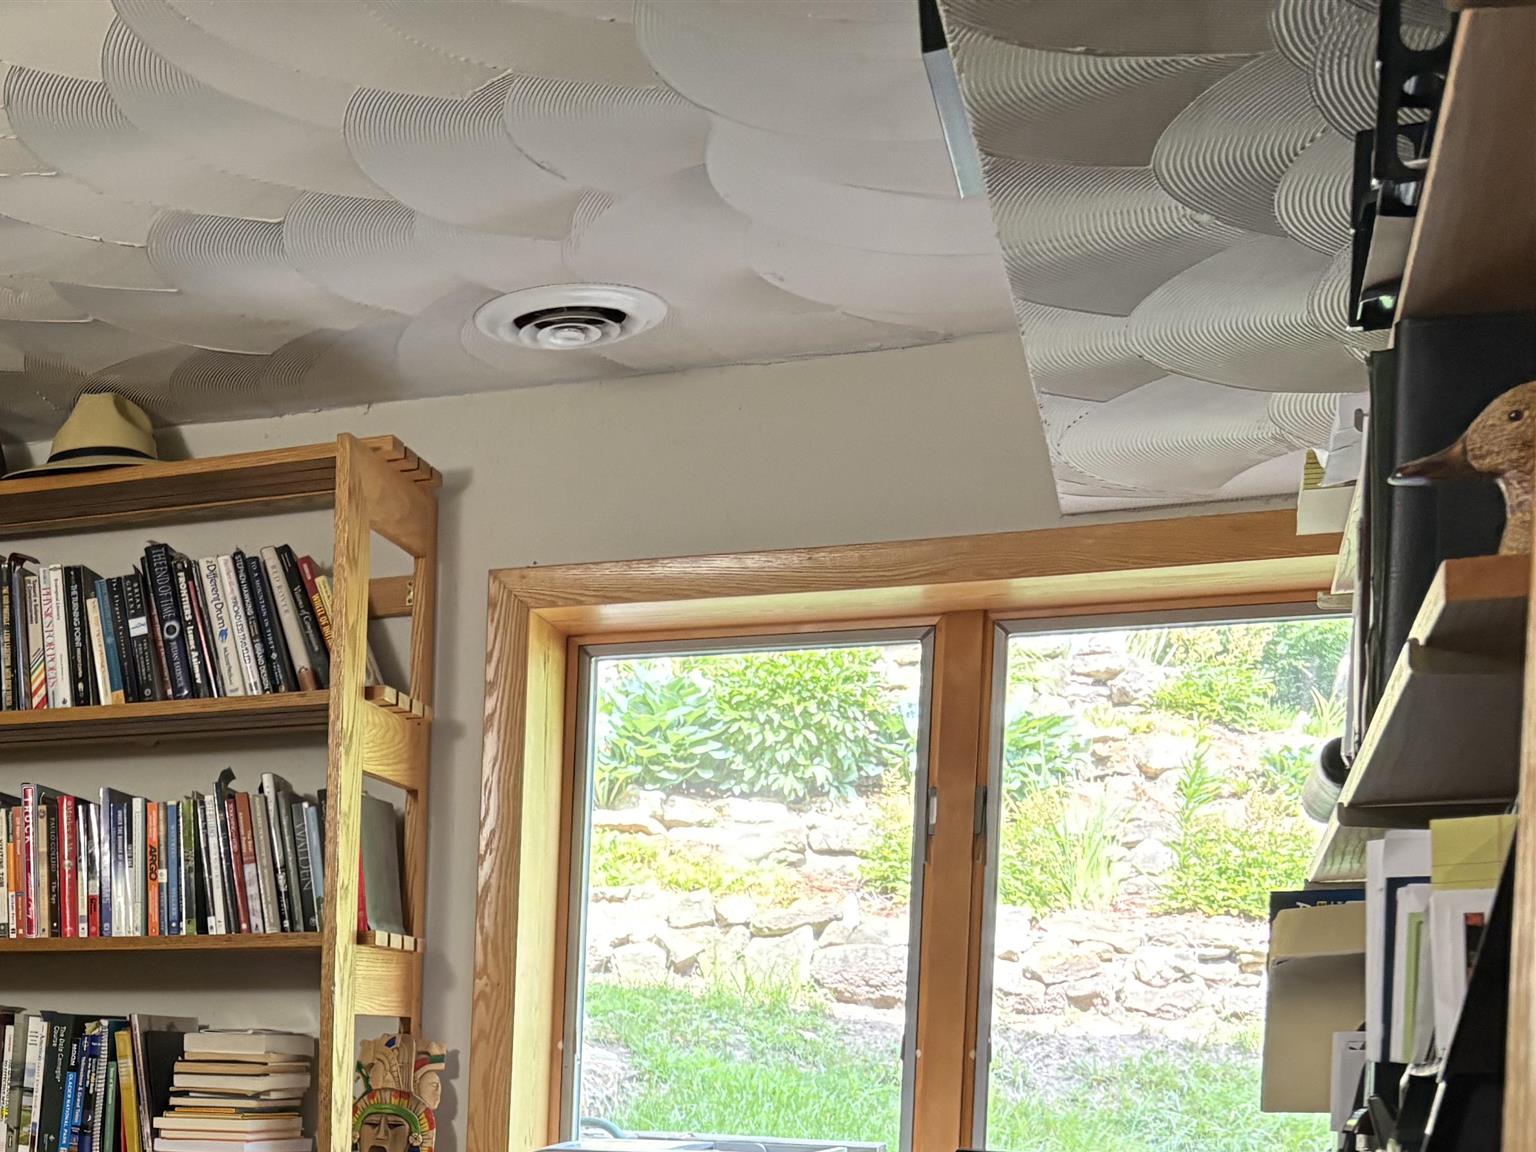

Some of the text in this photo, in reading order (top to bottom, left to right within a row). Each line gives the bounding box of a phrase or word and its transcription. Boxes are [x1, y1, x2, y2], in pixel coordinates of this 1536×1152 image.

[152, 547, 166, 566] THE
[155, 565, 171, 584] END
[125, 580, 135, 615] GREENE
[133, 582, 141, 611] BRIAN
[157, 584, 172, 599] OF
[160, 598, 176, 620] TIME
[207, 564, 226, 629] Different Drum
[250, 560, 257, 571] TO
[254, 579, 266, 617] MOUNTAIN
[311, 593, 325, 617] WHEEL
[70, 584, 82, 648] THE TURNING POINT
[177, 571, 203, 684] FRONTIERS Isaac Asimov
[232, 600, 240, 621] ROAD
[234, 554, 246, 583] STEPHEN
[242, 583, 255, 615] HAWKING
[258, 665, 269, 690] DESIGN
[42, 587, 57, 689] PHYSICS FOR POETS
[24, 798, 33, 844] TRUCK
[148, 844, 157, 882] ARGO
[295, 822, 312, 892] WALDEN
[52, 1025, 60, 1047] Course
[55, 1025, 67, 1082] The Dale Carnegie
[61, 1042, 78, 1144] MOON GLACIER NATIONAL PARK
